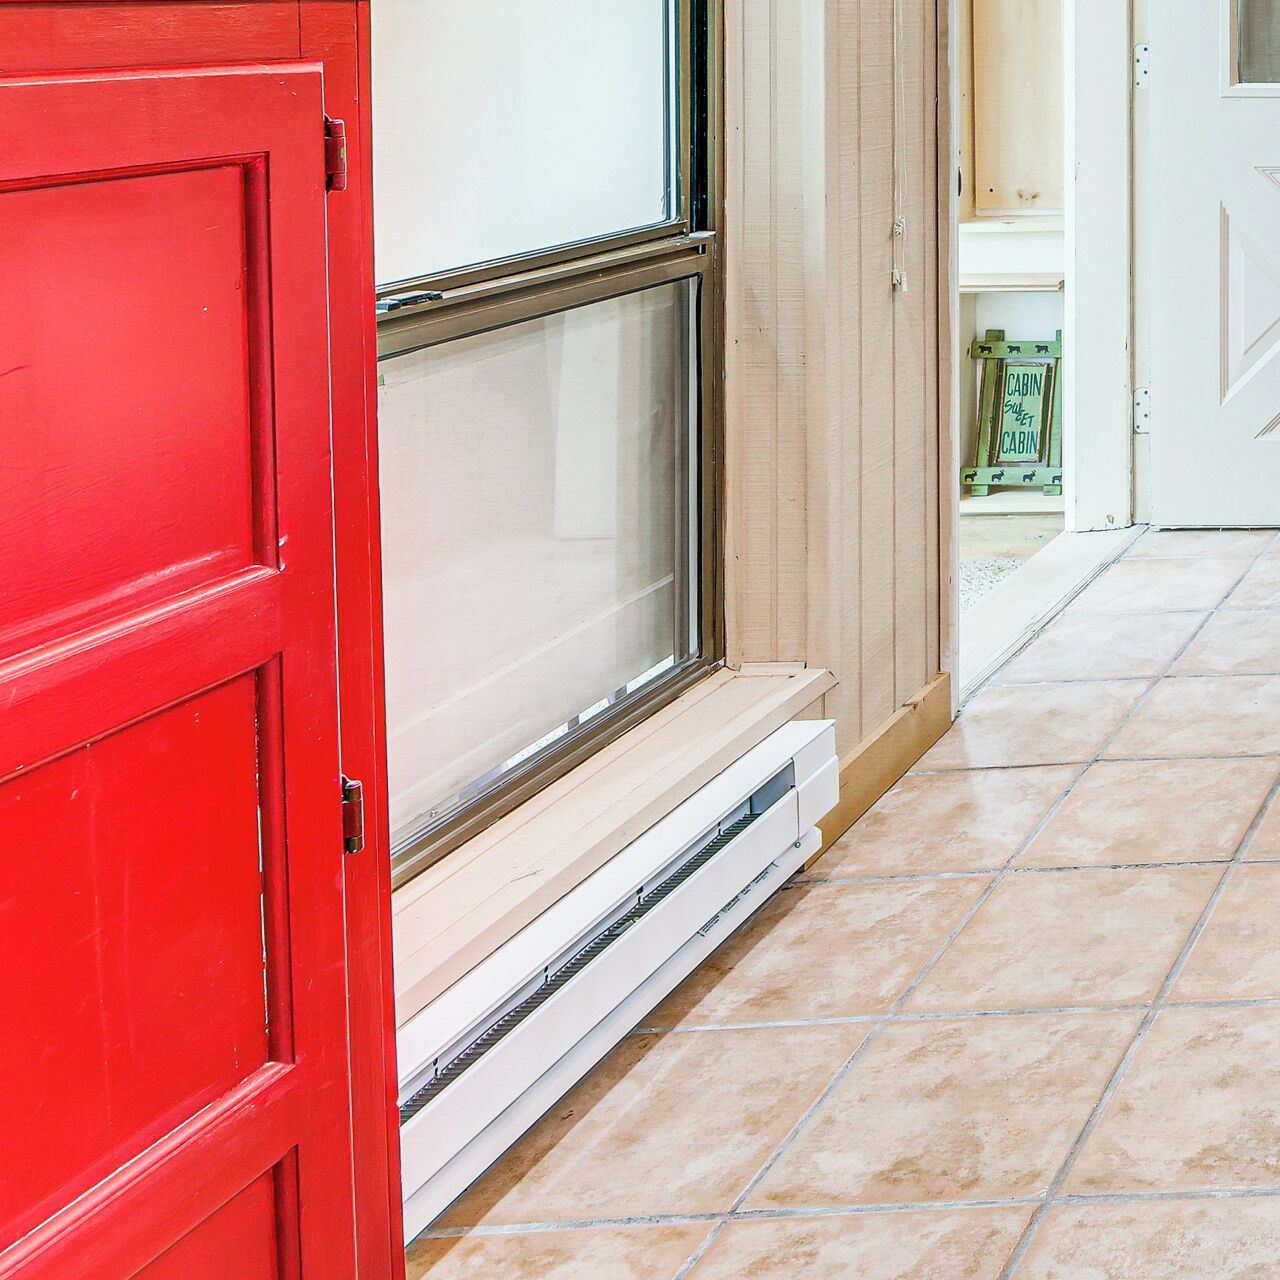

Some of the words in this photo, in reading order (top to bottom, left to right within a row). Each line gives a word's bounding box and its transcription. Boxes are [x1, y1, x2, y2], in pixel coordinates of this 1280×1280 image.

[1006, 373, 1043, 397] CABIN
[1004, 399, 1035, 428] SWEET
[1001, 430, 1038, 454] CABIN
